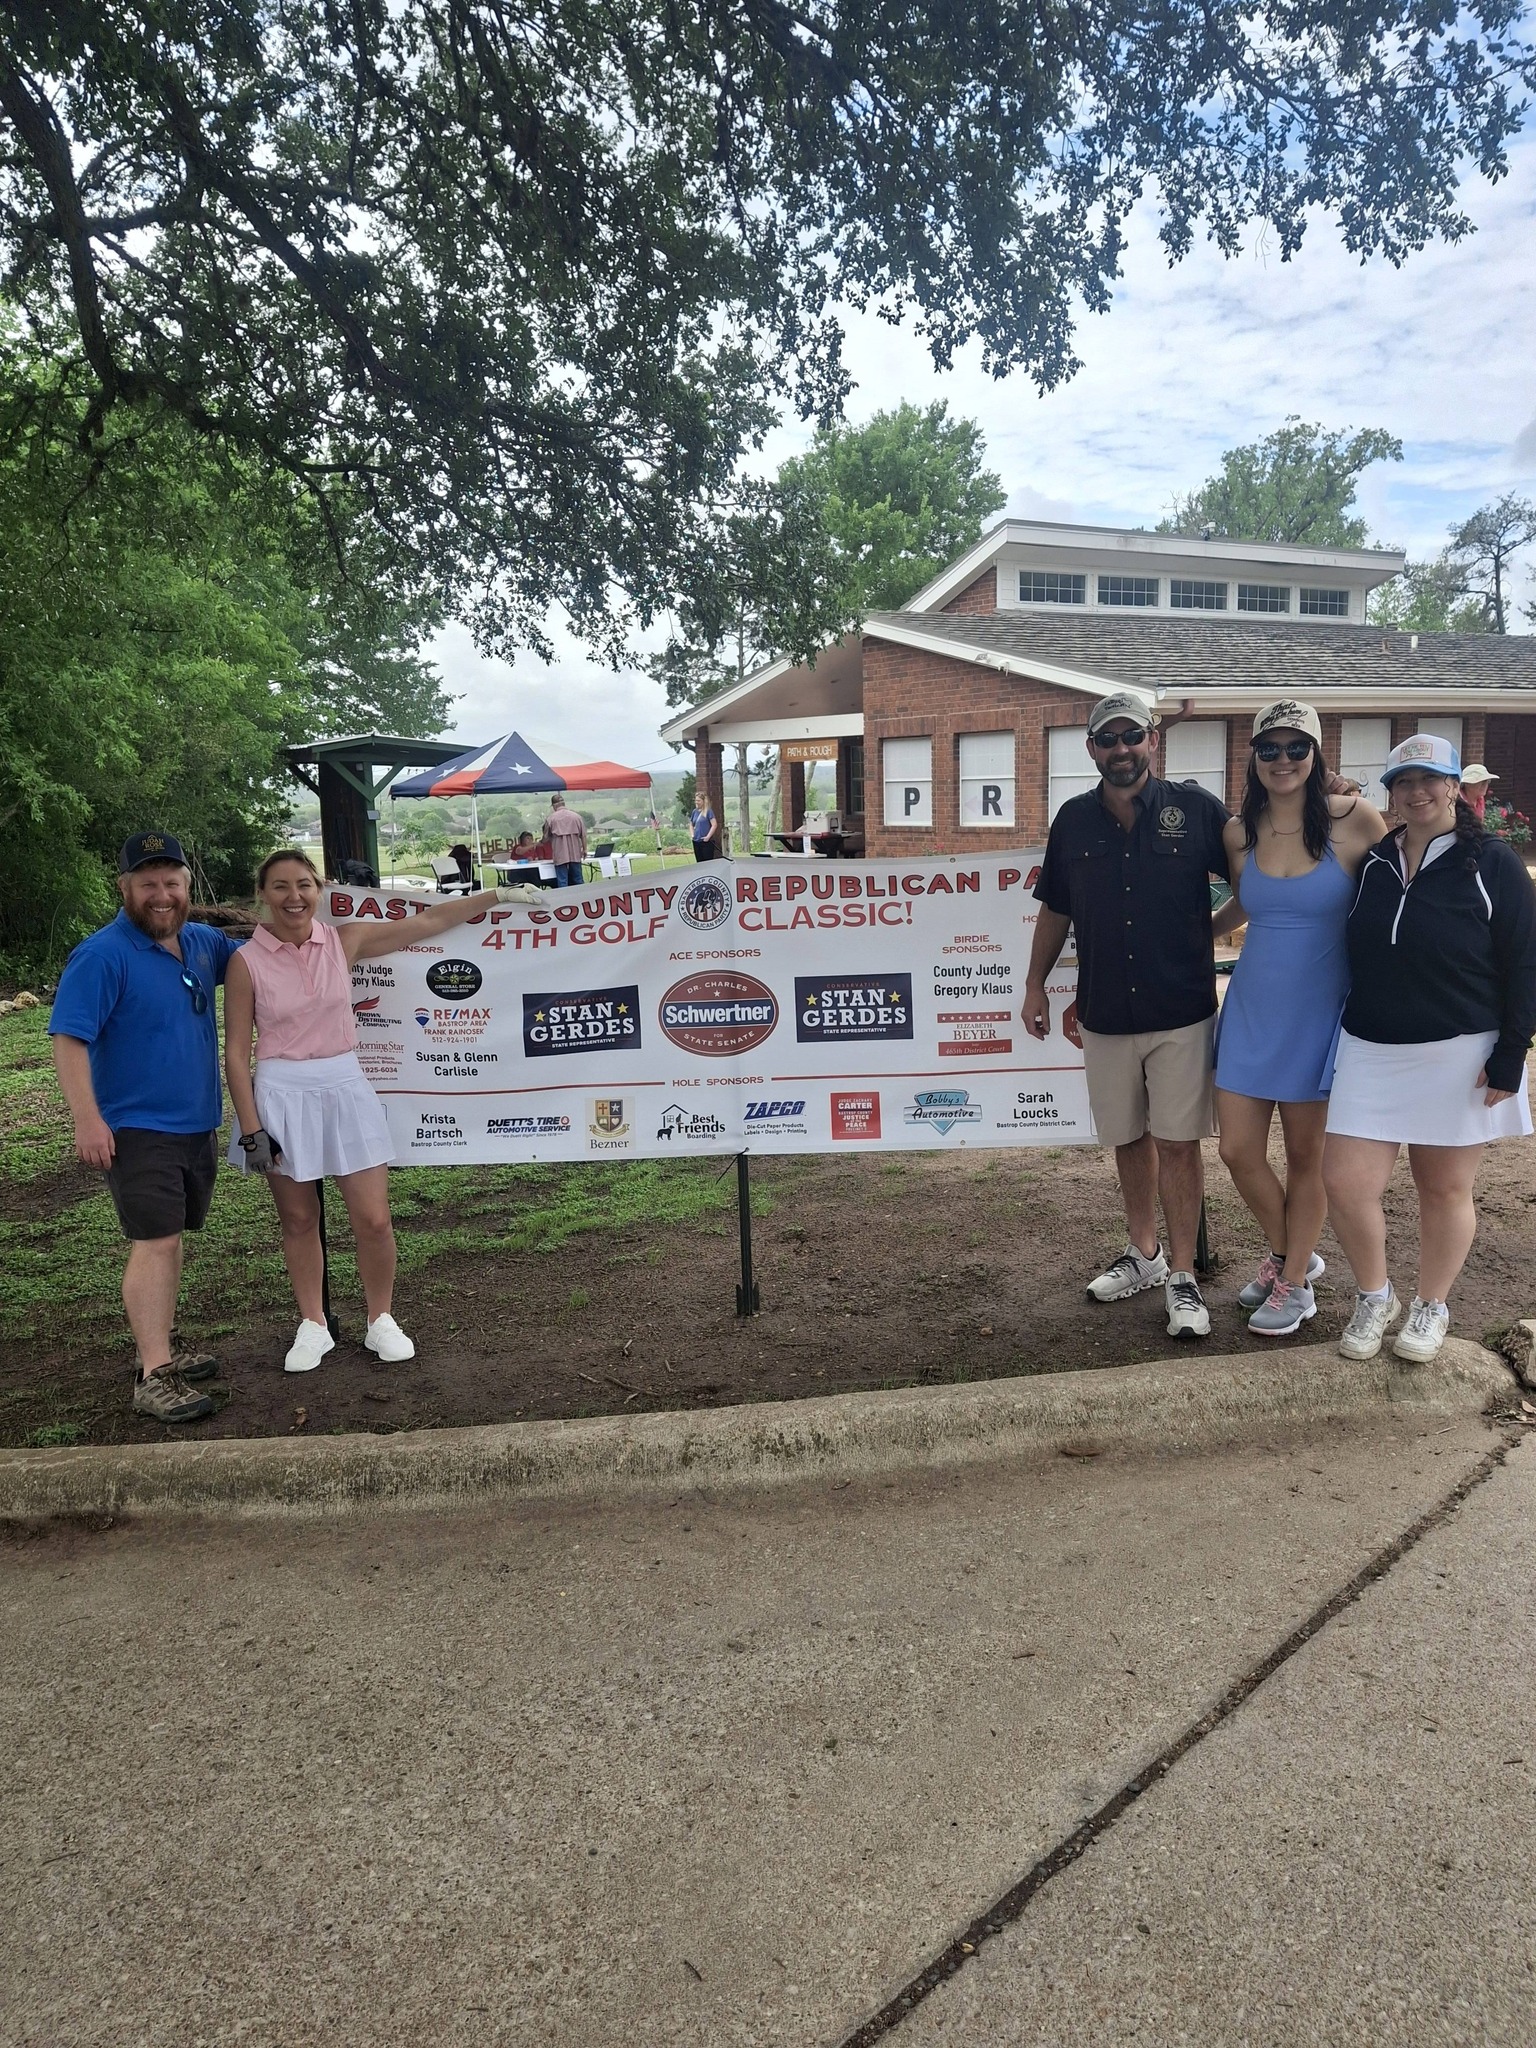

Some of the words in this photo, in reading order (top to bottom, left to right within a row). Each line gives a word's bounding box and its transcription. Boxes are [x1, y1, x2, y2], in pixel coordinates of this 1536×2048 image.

[787, 747, 801, 757] PATH
[803, 747, 808, 757] &
[810, 745, 832, 756] ROUGH
[904, 787, 920, 816] P
[982, 785, 1003, 816] R
[480, 839, 503, 854] THE
[681, 878, 705, 905] BASTROP
[708, 878, 730, 900] COUNTY
[330, 891, 512, 925] BASTP
[736, 871, 981, 902] REPUBLICAN
[682, 911, 714, 928] REPUBLICAN
[715, 909, 728, 925] PARTY
[481, 927, 558, 950] 4TH
[569, 914, 669, 945] GOLF
[738, 901, 913, 931] CLASSIC!
[954, 935, 989, 943] BIRDIE
[397, 945, 444, 953] ONSORS
[669, 952, 693, 960] ACE
[696, 949, 761, 959] SPONSORS
[942, 945, 1002, 954] SPONSORS
[351, 964, 364, 975] nty
[366, 964, 393, 977] Judge
[437, 963, 472, 975] Elgin
[933, 965, 972, 979] County
[976, 963, 1011, 978] Judge
[352, 977, 369, 988] gory
[371, 976, 395, 987] Klaus
[687, 985, 702, 994] DR.
[705, 981, 748, 992] CHARLES
[934, 984, 978, 998] Gregory
[982, 982, 1013, 995] Klaus
[821, 989, 885, 1007] STAN
[433, 1008, 491, 1020] RE/MAX
[549, 1002, 613, 1023] STAN
[665, 1004, 771, 1024] Schwertner
[802, 1007, 907, 1027] GERDES
[530, 1018, 635, 1042] GERDES
[953, 1029, 997, 1040] BEYER
[569, 1038, 616, 1047] REPRESENTATIVE
[683, 1033, 713, 1046] STATE
[717, 1030, 755, 1046] SENATE
[964, 1046, 986, 1054] District
[416, 1051, 450, 1062] Susan
[453, 1052, 461, 1062] &
[464, 1052, 498, 1062] Glenn
[434, 1065, 478, 1076] Carlisle
[672, 1078, 700, 1087] HOLE
[706, 1076, 764, 1086] SPONSORS
[925, 1095, 960, 1107] Bobby's
[1017, 1092, 1053, 1103] Sarah
[743, 1101, 806, 1120] ZAPCO
[912, 1107, 974, 1120] Automotive
[1013, 1107, 1058, 1119] Loucks
[421, 1113, 456, 1124] Krista
[487, 1117, 534, 1127] DUETT'S
[537, 1116, 561, 1125] TIRE
[692, 1114, 715, 1123] Best
[677, 1121, 726, 1133] Friends
[416, 1128, 462, 1139] Bartsch
[590, 1139, 630, 1149] Bezner
